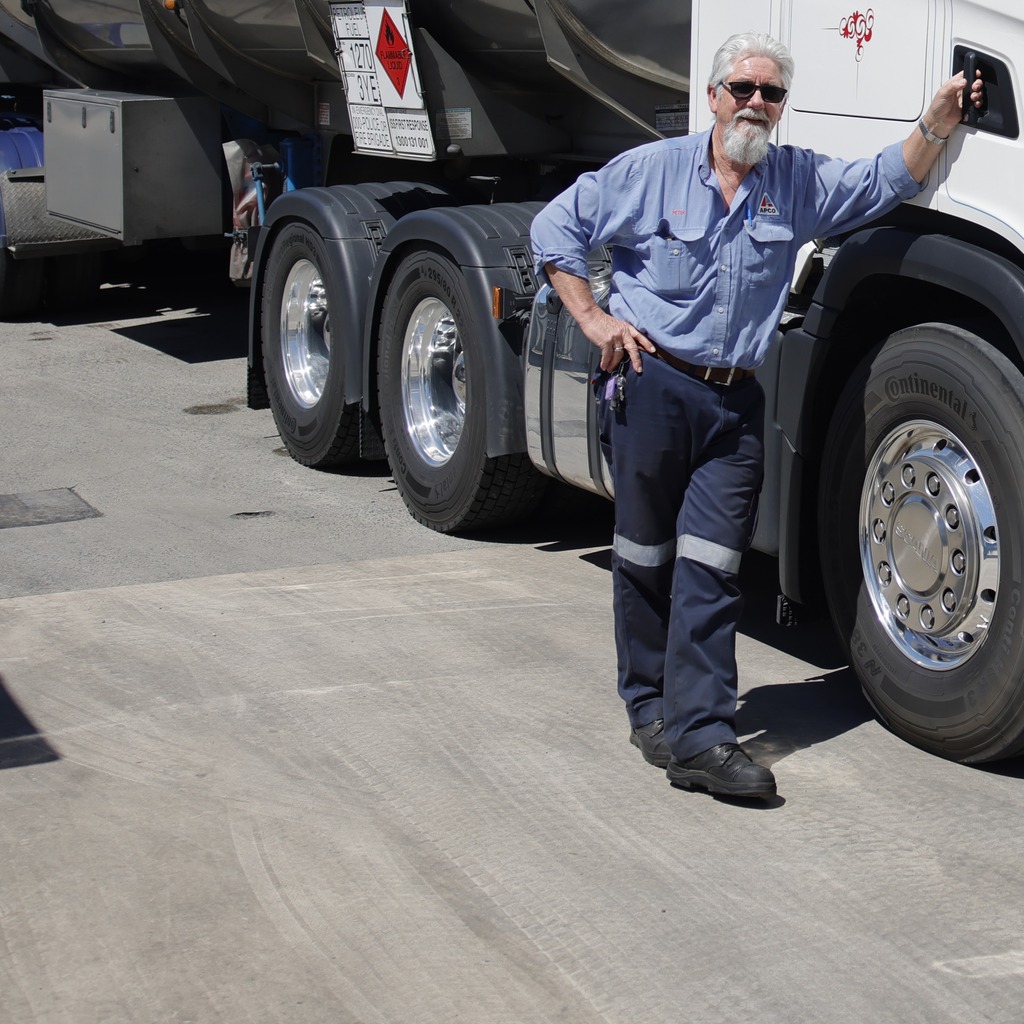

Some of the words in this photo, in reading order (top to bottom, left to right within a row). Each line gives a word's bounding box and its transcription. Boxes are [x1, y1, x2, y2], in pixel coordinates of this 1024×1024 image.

[345, 22, 362, 37] FUEL
[350, 42, 373, 70] 1270
[388, 61, 403, 70] LIQUID
[357, 74, 379, 102] 3YE
[427, 267, 451, 297] 295/80
[883, 372, 968, 423] Continental
[894, 521, 939, 575] SCANIA
